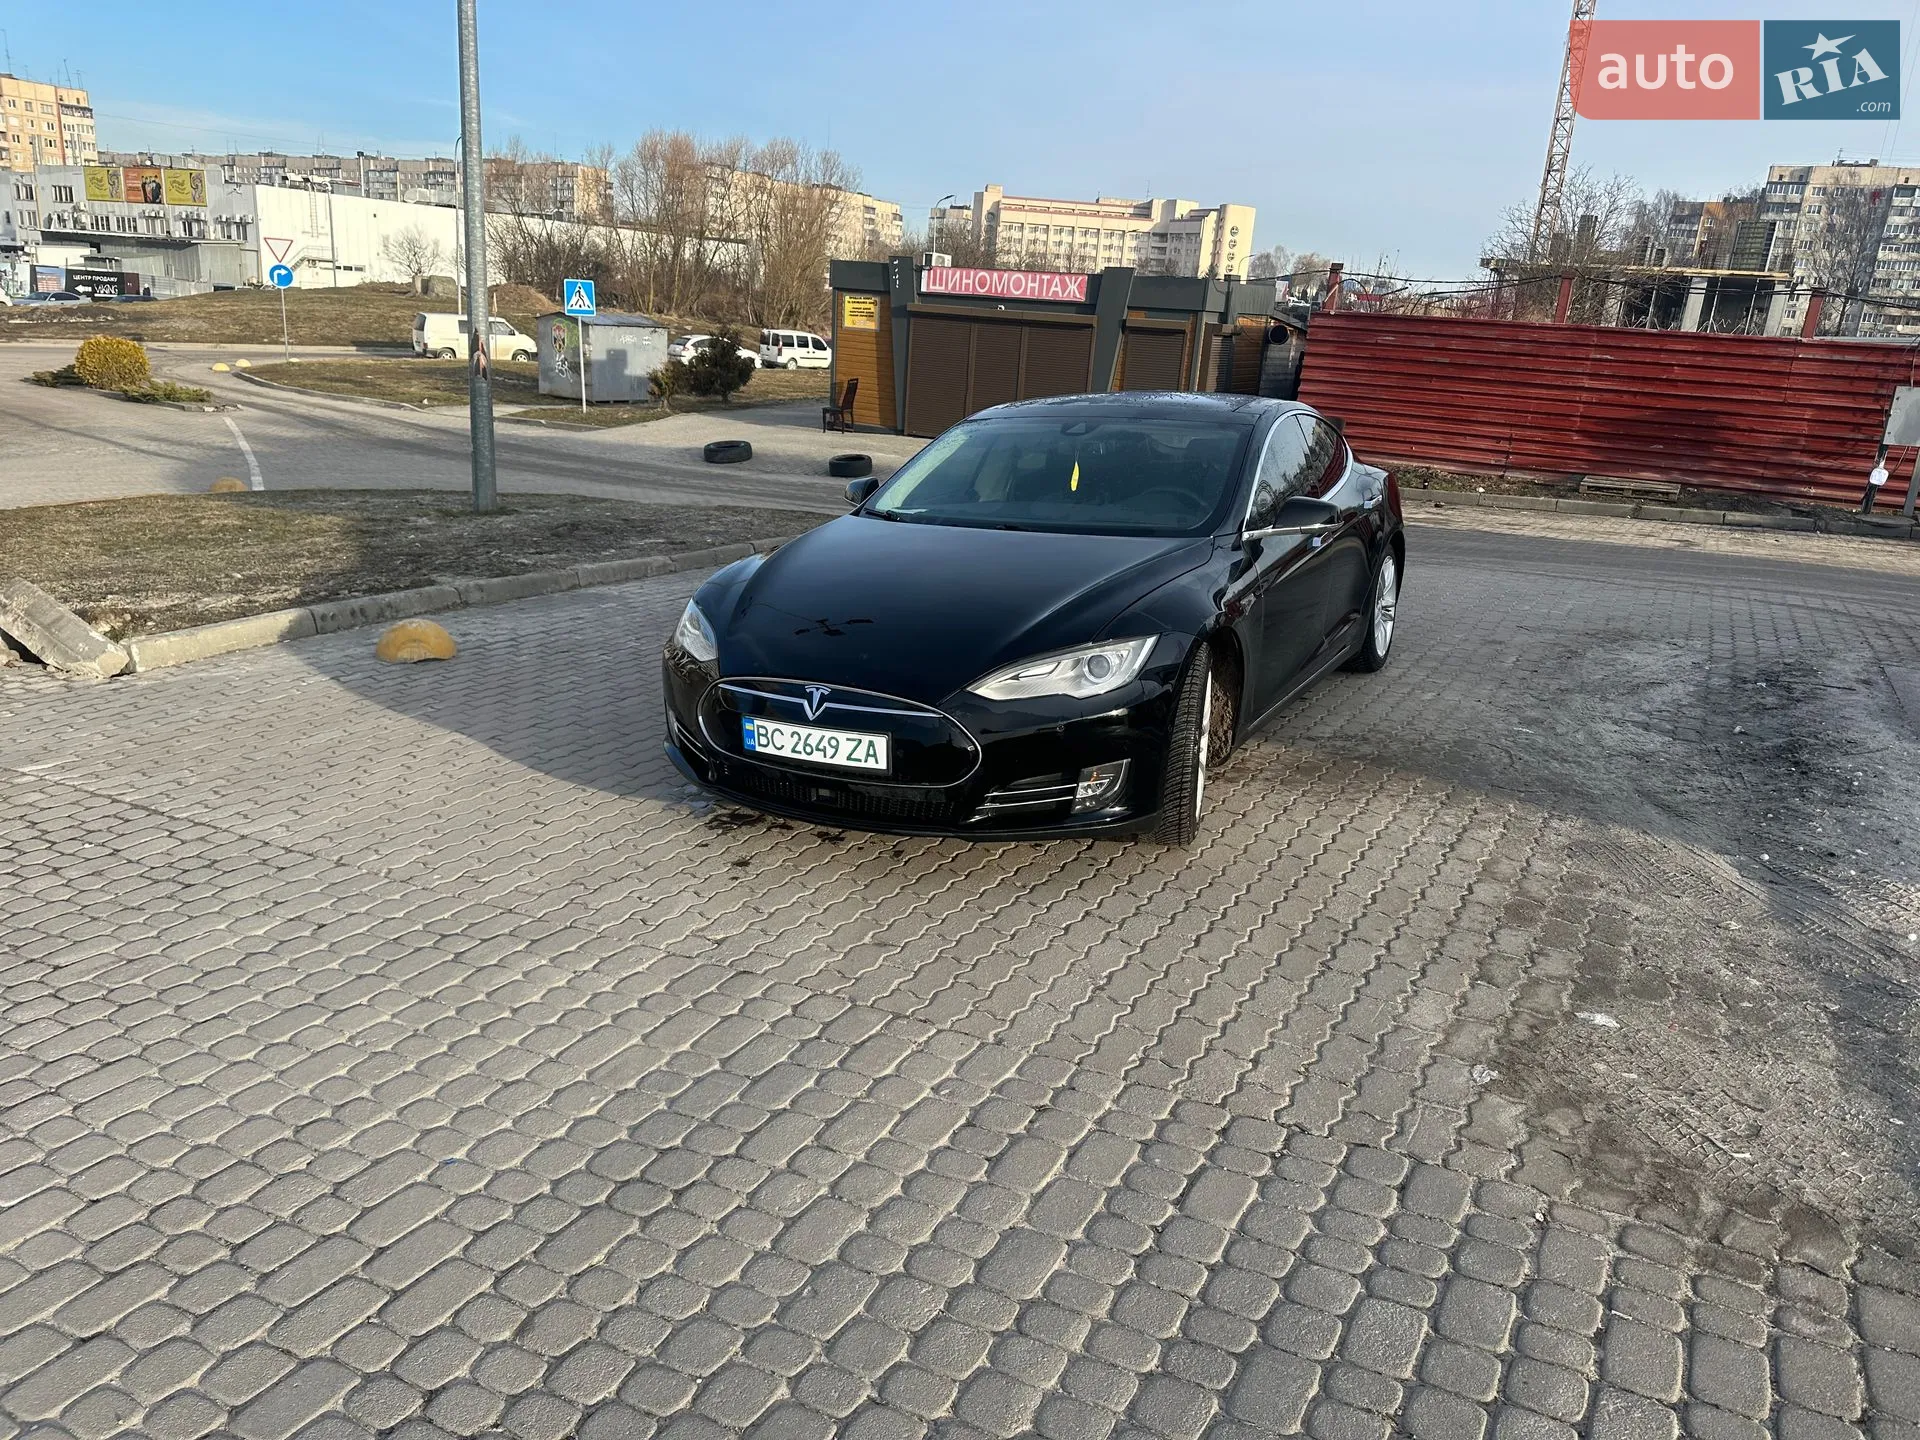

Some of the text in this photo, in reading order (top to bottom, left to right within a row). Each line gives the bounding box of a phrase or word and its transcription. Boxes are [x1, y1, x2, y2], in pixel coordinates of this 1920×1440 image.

[929, 268, 1081, 298] ШИНОМОНТАЖ
[746, 738, 755, 746] UA
[756, 724, 879, 765] BC 2649 ZA
